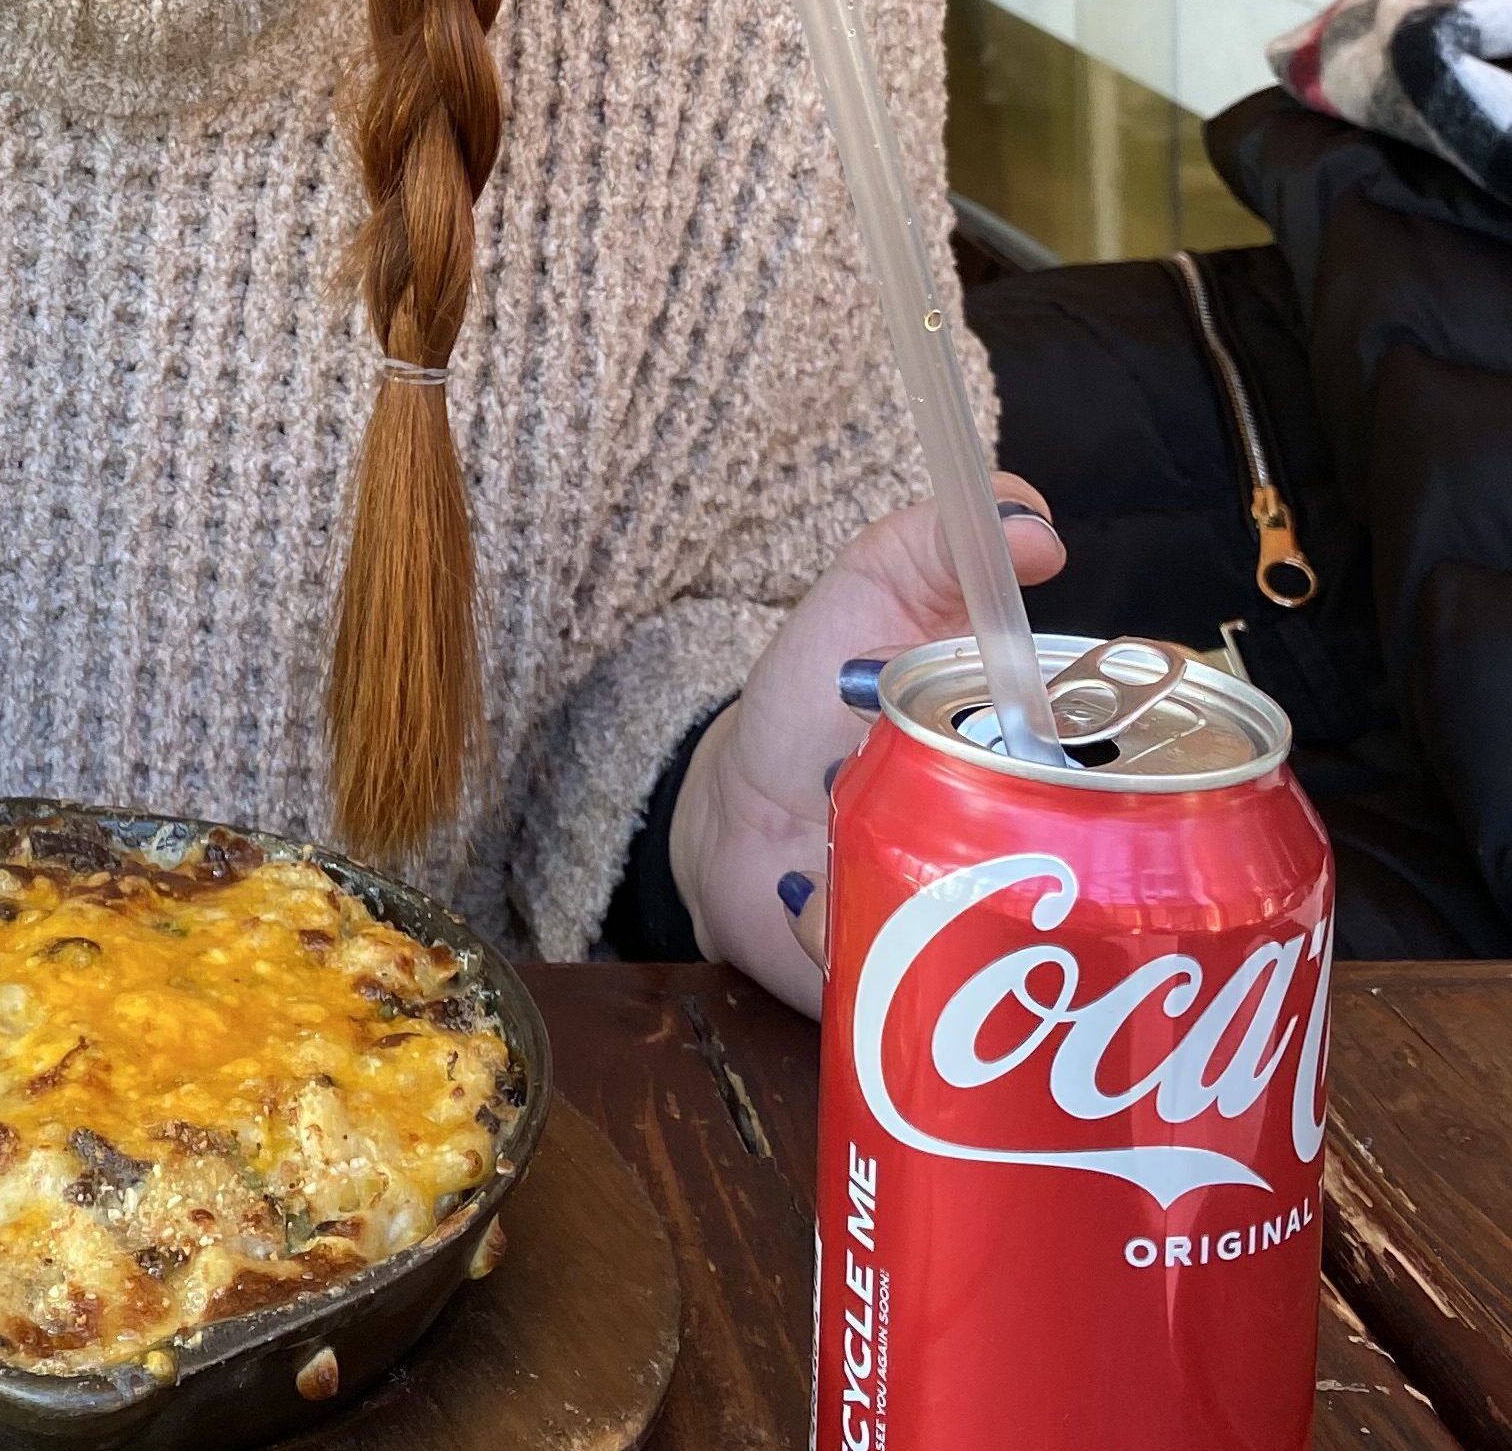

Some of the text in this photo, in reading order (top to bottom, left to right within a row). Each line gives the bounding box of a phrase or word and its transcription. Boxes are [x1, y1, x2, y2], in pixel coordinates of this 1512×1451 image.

[1124, 1197, 1313, 1268] ORIGINAL
[840, 1140, 877, 1451] CYCLE ME
[877, 1325, 889, 1382] AGAIN
[875, 1381, 887, 1416] YOU
[875, 1418, 886, 1451] SEE
